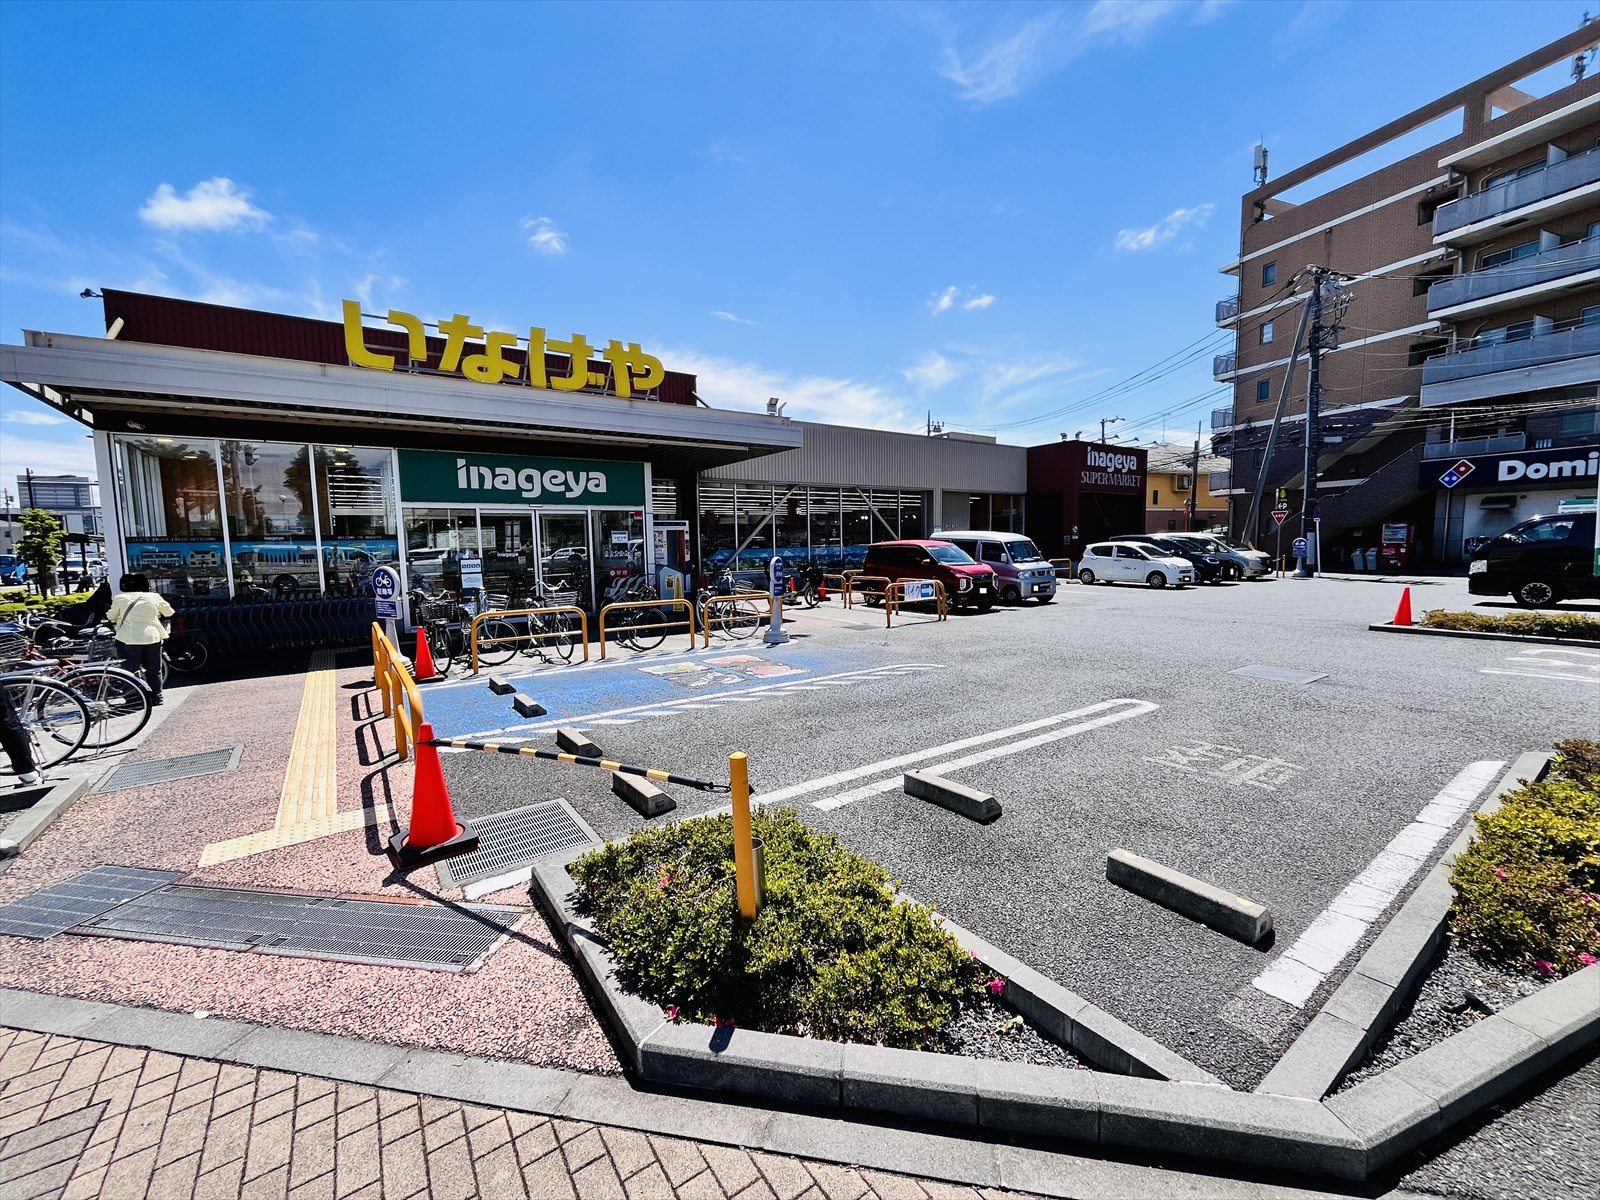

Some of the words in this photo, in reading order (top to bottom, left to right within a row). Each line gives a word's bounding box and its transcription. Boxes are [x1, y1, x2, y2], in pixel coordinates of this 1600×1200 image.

[342, 299, 665, 398] いなげや
[1087, 446, 1137, 473] inageya
[456, 458, 607, 498] inageya
[1080, 471, 1142, 487] SUPERMARKET
